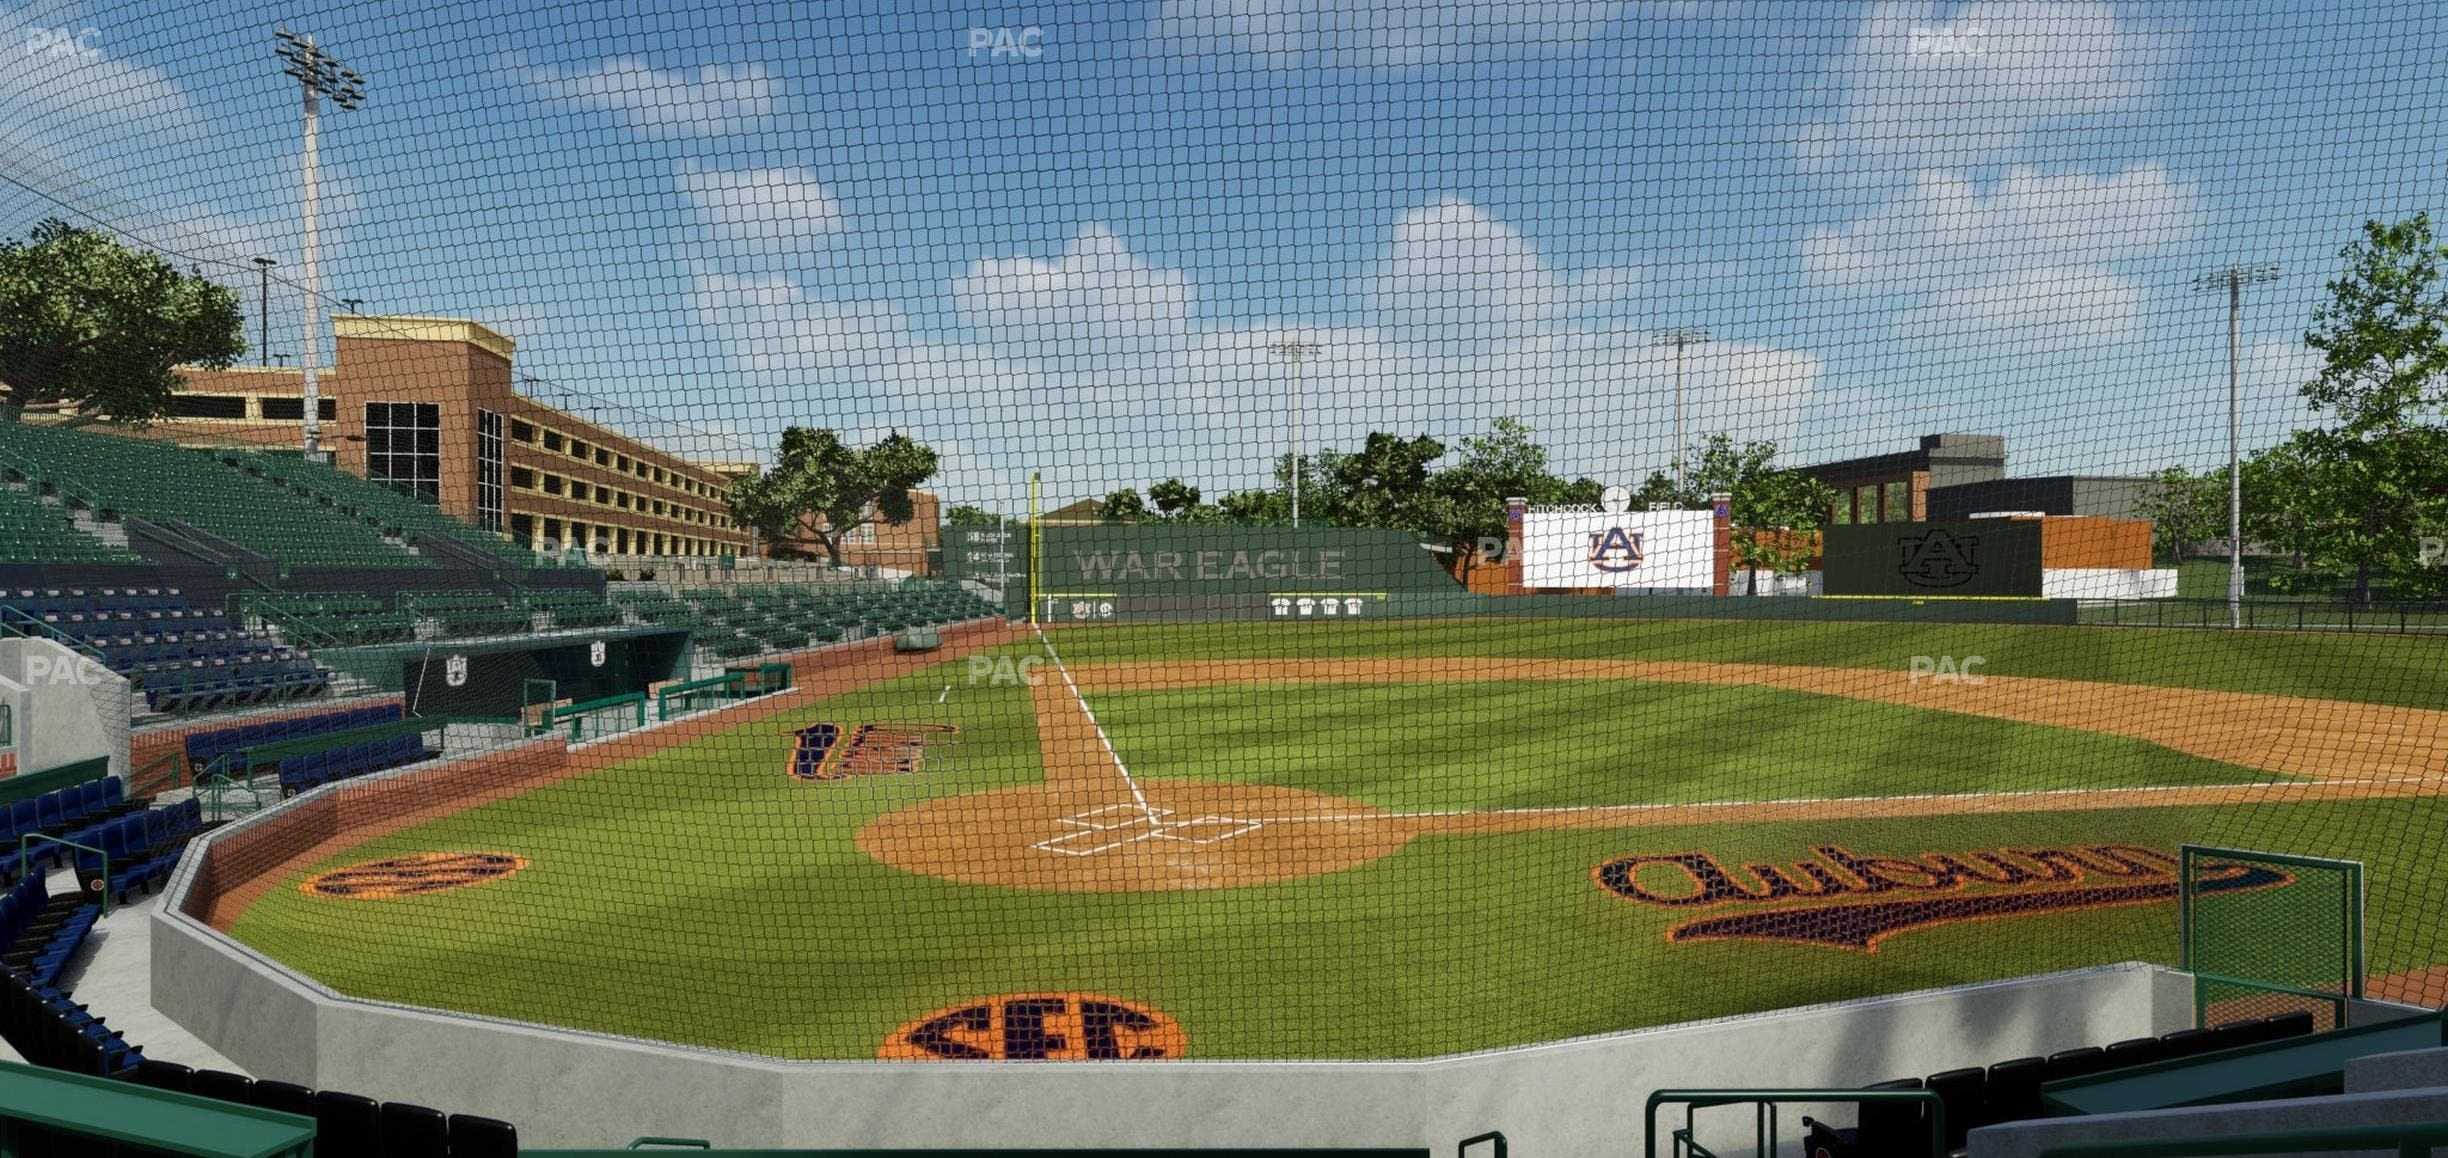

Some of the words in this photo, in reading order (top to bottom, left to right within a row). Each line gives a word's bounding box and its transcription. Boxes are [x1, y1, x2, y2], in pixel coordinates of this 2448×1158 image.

[1528, 502, 1597, 514] HITCHCOCK
[1649, 502, 1684, 512] FIELD
[1073, 550, 1183, 580] WAR
[1197, 550, 1346, 580] EAGLE
